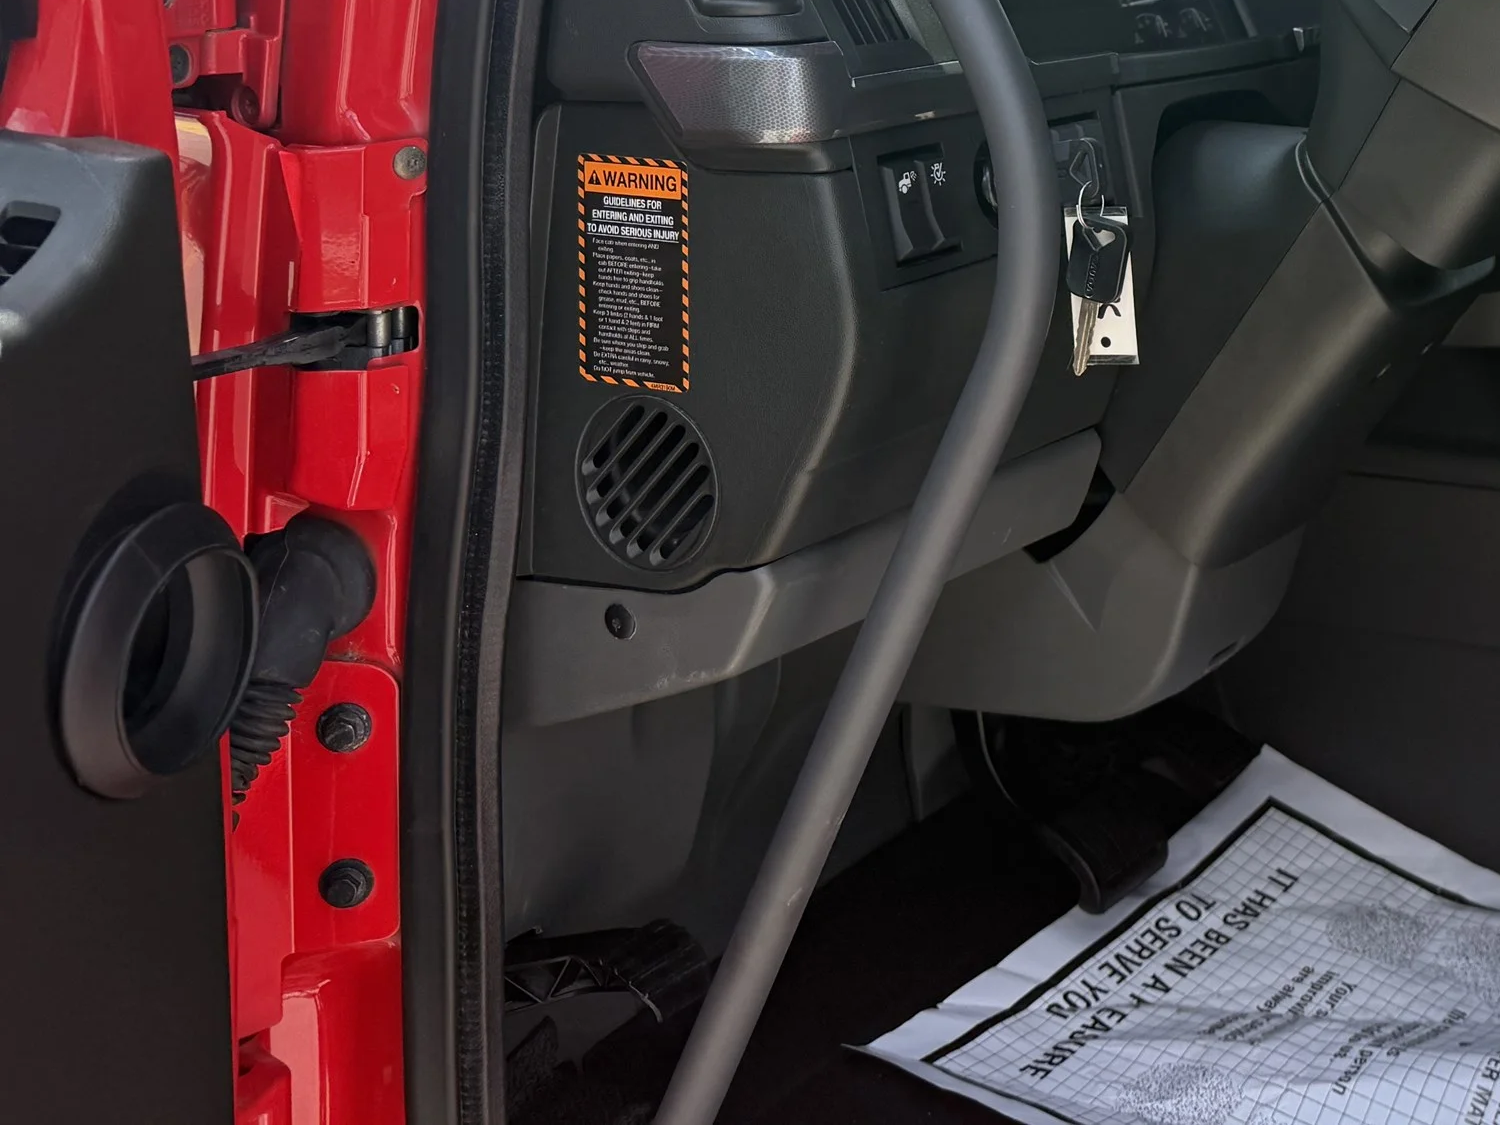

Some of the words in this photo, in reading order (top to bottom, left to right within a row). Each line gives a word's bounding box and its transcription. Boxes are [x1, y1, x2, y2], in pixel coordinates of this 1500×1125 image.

[603, 170, 678, 193] WARNING
[592, 209, 627, 221] ENTERING
[629, 213, 644, 223] AND
[646, 215, 674, 225] EXITING
[604, 196, 646, 208] GUIDELINES
[647, 200, 662, 209] FOR
[587, 223, 597, 232] TO
[598, 225, 619, 234] AVOID
[621, 227, 652, 238] SERIOUS
[654, 230, 679, 240] INJURY
[1267, 868, 1299, 893] IT
[1175, 893, 1217, 922] TO
[1223, 889, 1277, 931] HAS
[1098, 916, 1182, 985] SERVE
[1164, 927, 1232, 978] BEEN
[1142, 974, 1172, 994] A
[1291, 964, 1315, 985] are
[1045, 979, 1109, 1020] YOU
[1255, 983, 1297, 1014] alway
[1325, 981, 1358, 1010] Your
[1018, 992, 1150, 1080] EASURE
[1331, 1049, 1374, 1096] person
